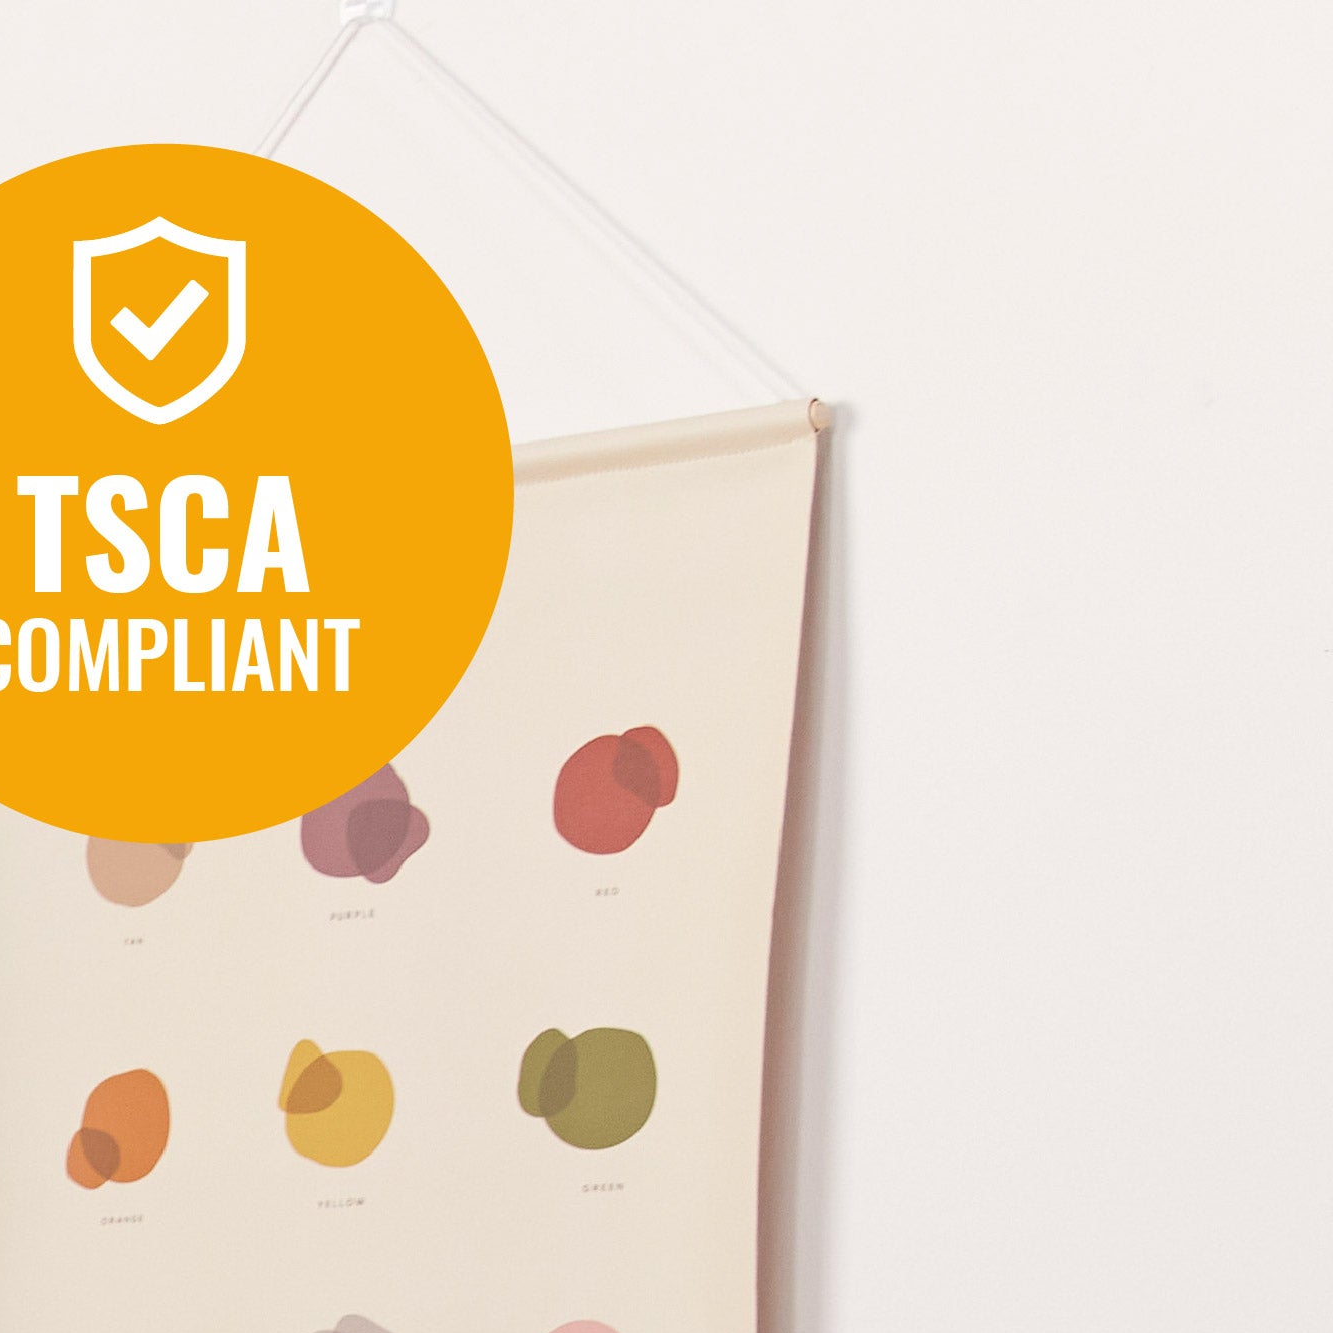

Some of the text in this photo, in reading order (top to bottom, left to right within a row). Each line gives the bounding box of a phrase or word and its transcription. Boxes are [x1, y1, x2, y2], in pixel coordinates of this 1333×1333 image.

[595, 887, 620, 898] RED
[329, 908, 375, 921] PURPLE
[581, 1182, 625, 1193] GREEN
[317, 1198, 365, 1210] YELLOW
[100, 1214, 144, 1226] ORANGE
